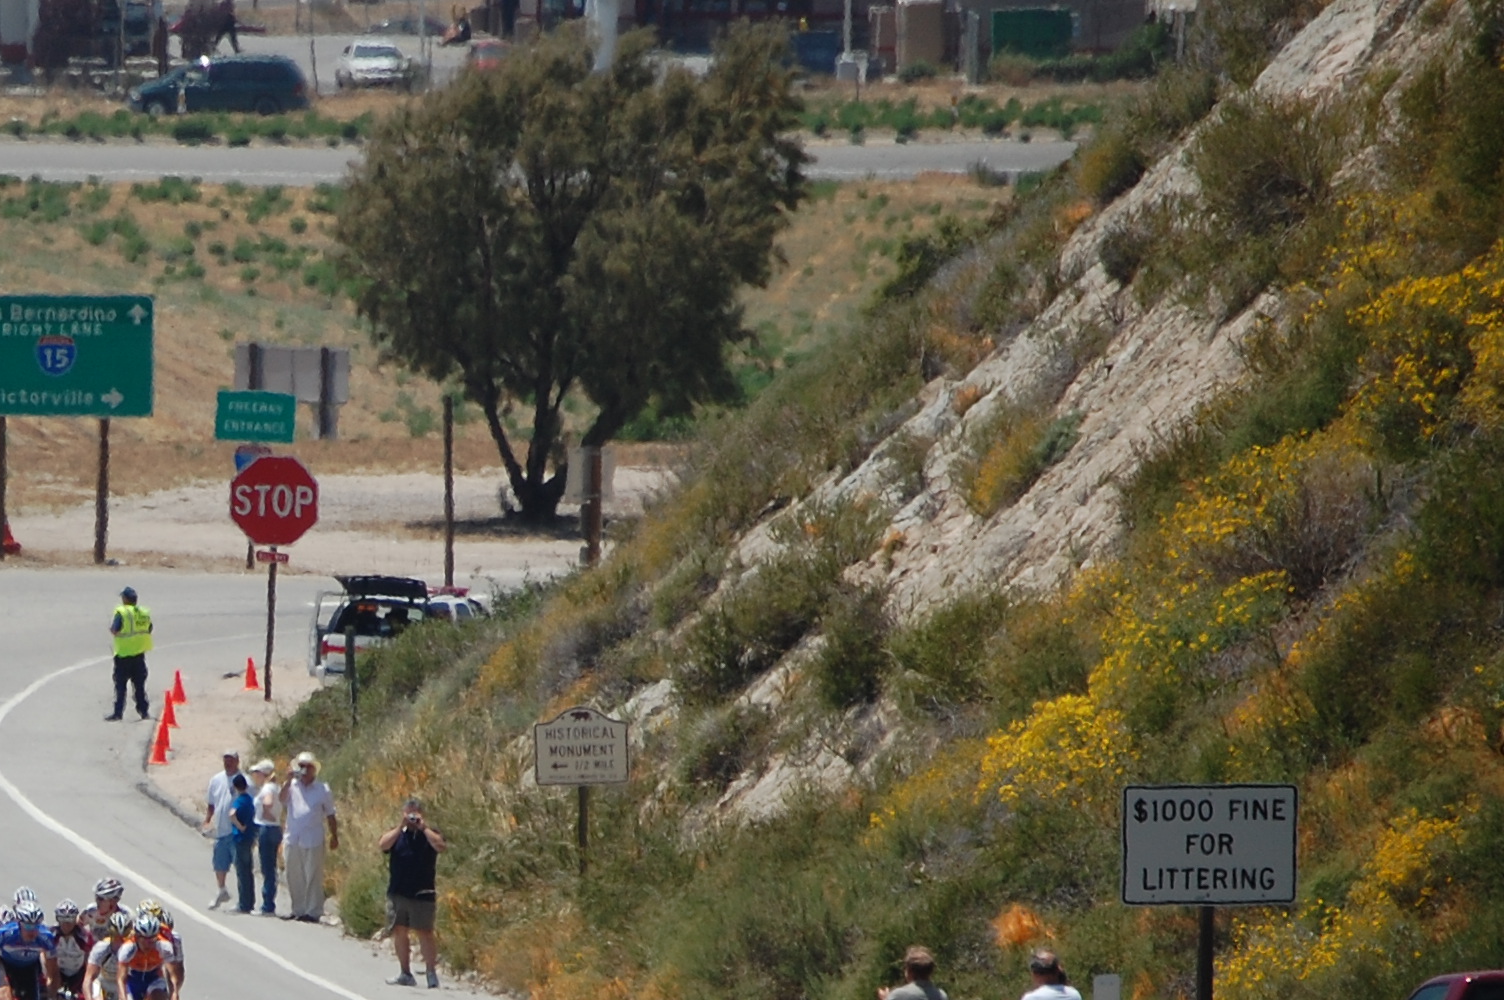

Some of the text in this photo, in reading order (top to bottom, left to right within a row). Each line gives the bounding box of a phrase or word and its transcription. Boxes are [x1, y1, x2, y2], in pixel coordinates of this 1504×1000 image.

[9, 303, 117, 322] Bernardino
[2, 322, 103, 336] RIGHT LANE
[44, 348, 70, 368] 15
[228, 401, 284, 414] FREEWAY
[224, 420, 287, 434] ENTRANCE
[234, 484, 314, 519] STOP
[545, 727, 617, 740] HISTORICAL
[549, 744, 615, 757] MONUMENT
[594, 760, 614, 769] MILE
[1133, 798, 1286, 823] $1000 FINE
[1186, 833, 1234, 855] FOR
[1143, 867, 1275, 890] LITTERING
